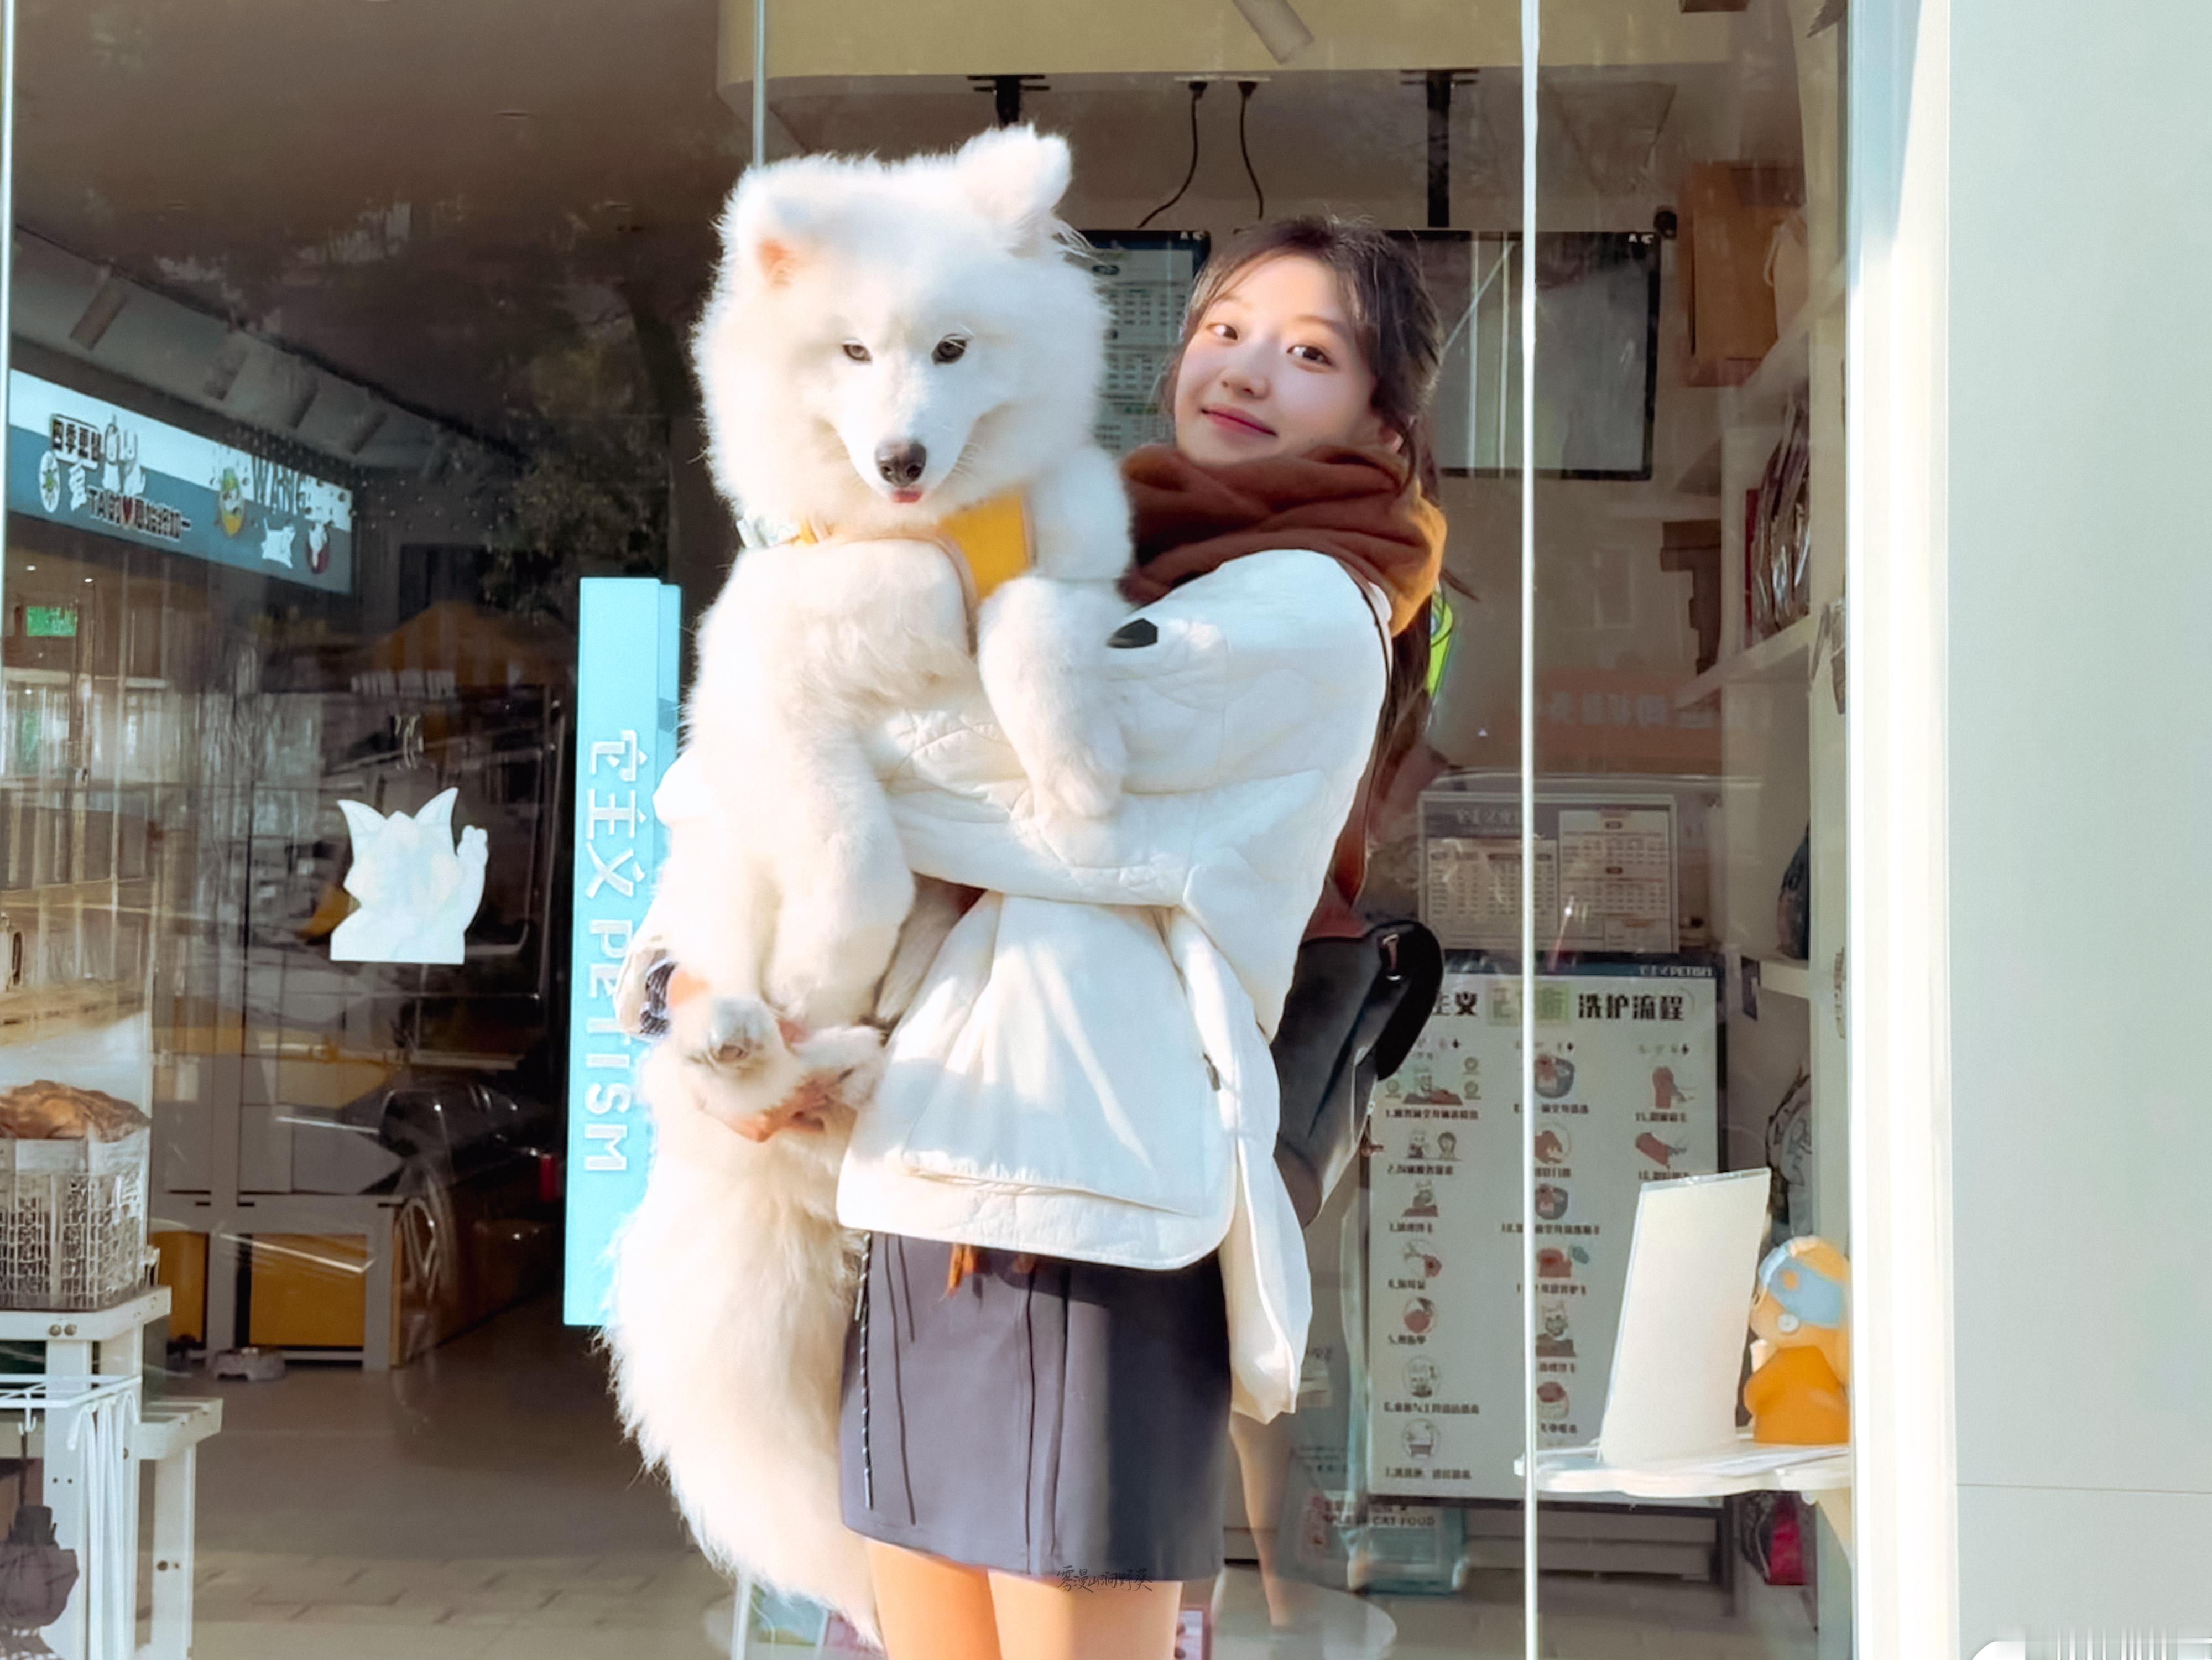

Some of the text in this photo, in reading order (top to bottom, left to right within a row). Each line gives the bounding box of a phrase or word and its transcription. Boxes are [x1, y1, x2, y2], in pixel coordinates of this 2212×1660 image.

[585, 729, 647, 1172] 它主义 PETISM
[1578, 993, 1684, 1021] 洗护流程
